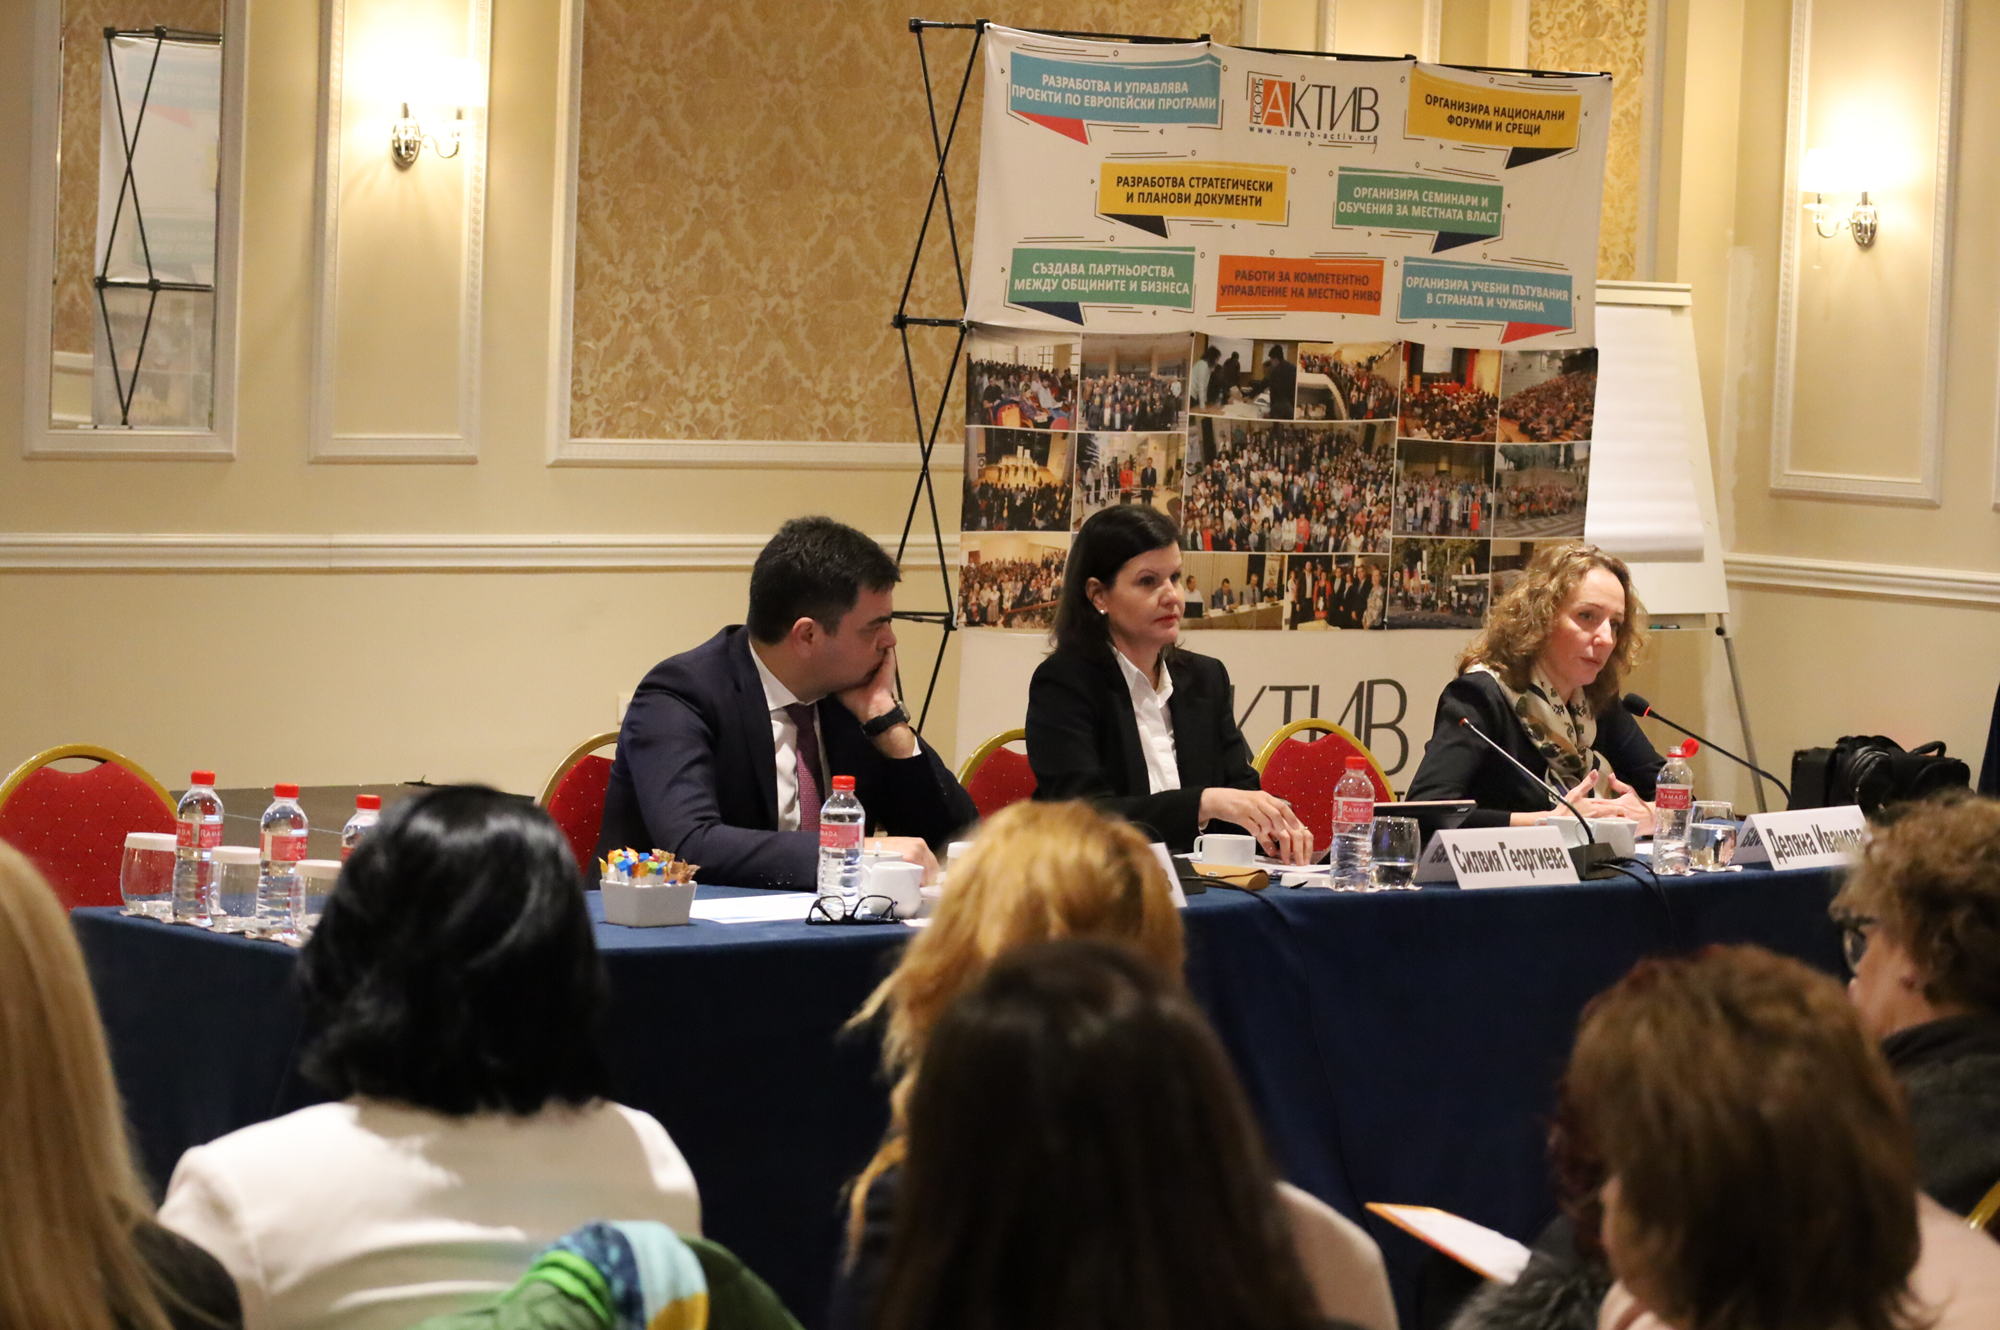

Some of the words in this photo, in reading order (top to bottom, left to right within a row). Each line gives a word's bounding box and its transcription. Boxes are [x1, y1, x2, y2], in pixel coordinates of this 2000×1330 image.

[1042, 74, 1111, 93] РАЗРАБОТВА
[1114, 82, 1122, 93] И
[1125, 81, 1189, 94] УПРАВЛЯВА
[1011, 84, 1062, 103] ПРОЕКТИ
[1065, 92, 1081, 106] ПО
[1084, 94, 1155, 109] ЕВРОПЕЙСКИ
[1158, 97, 1216, 110] ПРОГРАМИ
[1252, 77, 1264, 125] НСОРБ
[1261, 81, 1380, 132] АКТИВ
[1425, 93, 1490, 116] ОРГАНИЗИРА
[1493, 106, 1565, 121] НАЦИОНАЛНИ
[1249, 126, 1378, 143] www.namrb-activ.org
[1447, 114, 1492, 131] ФОРУМИ
[1495, 122, 1502, 132] И
[1505, 122, 1541, 136] СРЕЩИ
[1116, 176, 1185, 188] РАЗРАБОТВА
[1188, 176, 1273, 192] СТРАТЕГИЧЕСКИ
[1126, 192, 1134, 203] И
[1137, 192, 1191, 204] ПЛАНОВИ
[1194, 193, 1262, 207] ДОКУМЕНТИ
[1353, 187, 1419, 202] ОРГАНИЗИРА
[1422, 191, 1479, 206] СЕМИНАРИ
[1481, 197, 1489, 207] И
[1338, 201, 1393, 215] ОБУЧЕНИЯ
[1396, 204, 1409, 216] ЗА
[1411, 205, 1464, 220] МЕСТНАТА
[1466, 210, 1498, 223] ВЛАСТ
[1032, 263, 1085, 276] СЪЗДАВА
[1089, 264, 1175, 278] ПАРТНЬОРСТВА
[1235, 269, 1275, 282] РАБОТИ
[1278, 271, 1290, 282] ЗА
[1294, 272, 1369, 286] КОМПЕТЕНТНО
[1014, 279, 1058, 292] МЕЖДУ
[1061, 279, 1126, 292] ОБЩИНИТЕ
[1129, 281, 1138, 292] И
[1140, 281, 1190, 294] БИЗНЕСА
[1221, 285, 1288, 297] УПРАВЛЕНИЕ
[1291, 286, 1304, 298] НА
[1308, 287, 1350, 300] МЕСТНО
[1353, 290, 1381, 302] НИВО
[1406, 276, 1469, 291] ОРГАНИЗИРА
[1471, 281, 1509, 294] УЧЕБНИ
[1512, 284, 1569, 301] ПЪТУВАНИЯ
[1426, 292, 1433, 304] В
[1436, 293, 1484, 307] СТРАНАТА
[1487, 297, 1494, 308] И
[1496, 299, 1545, 313] ЧУЖБИНА
[1766, 828, 1818, 864] Деляна
[1452, 843, 1504, 874] Силвия
[1498, 841, 1569, 878] Георгиева
